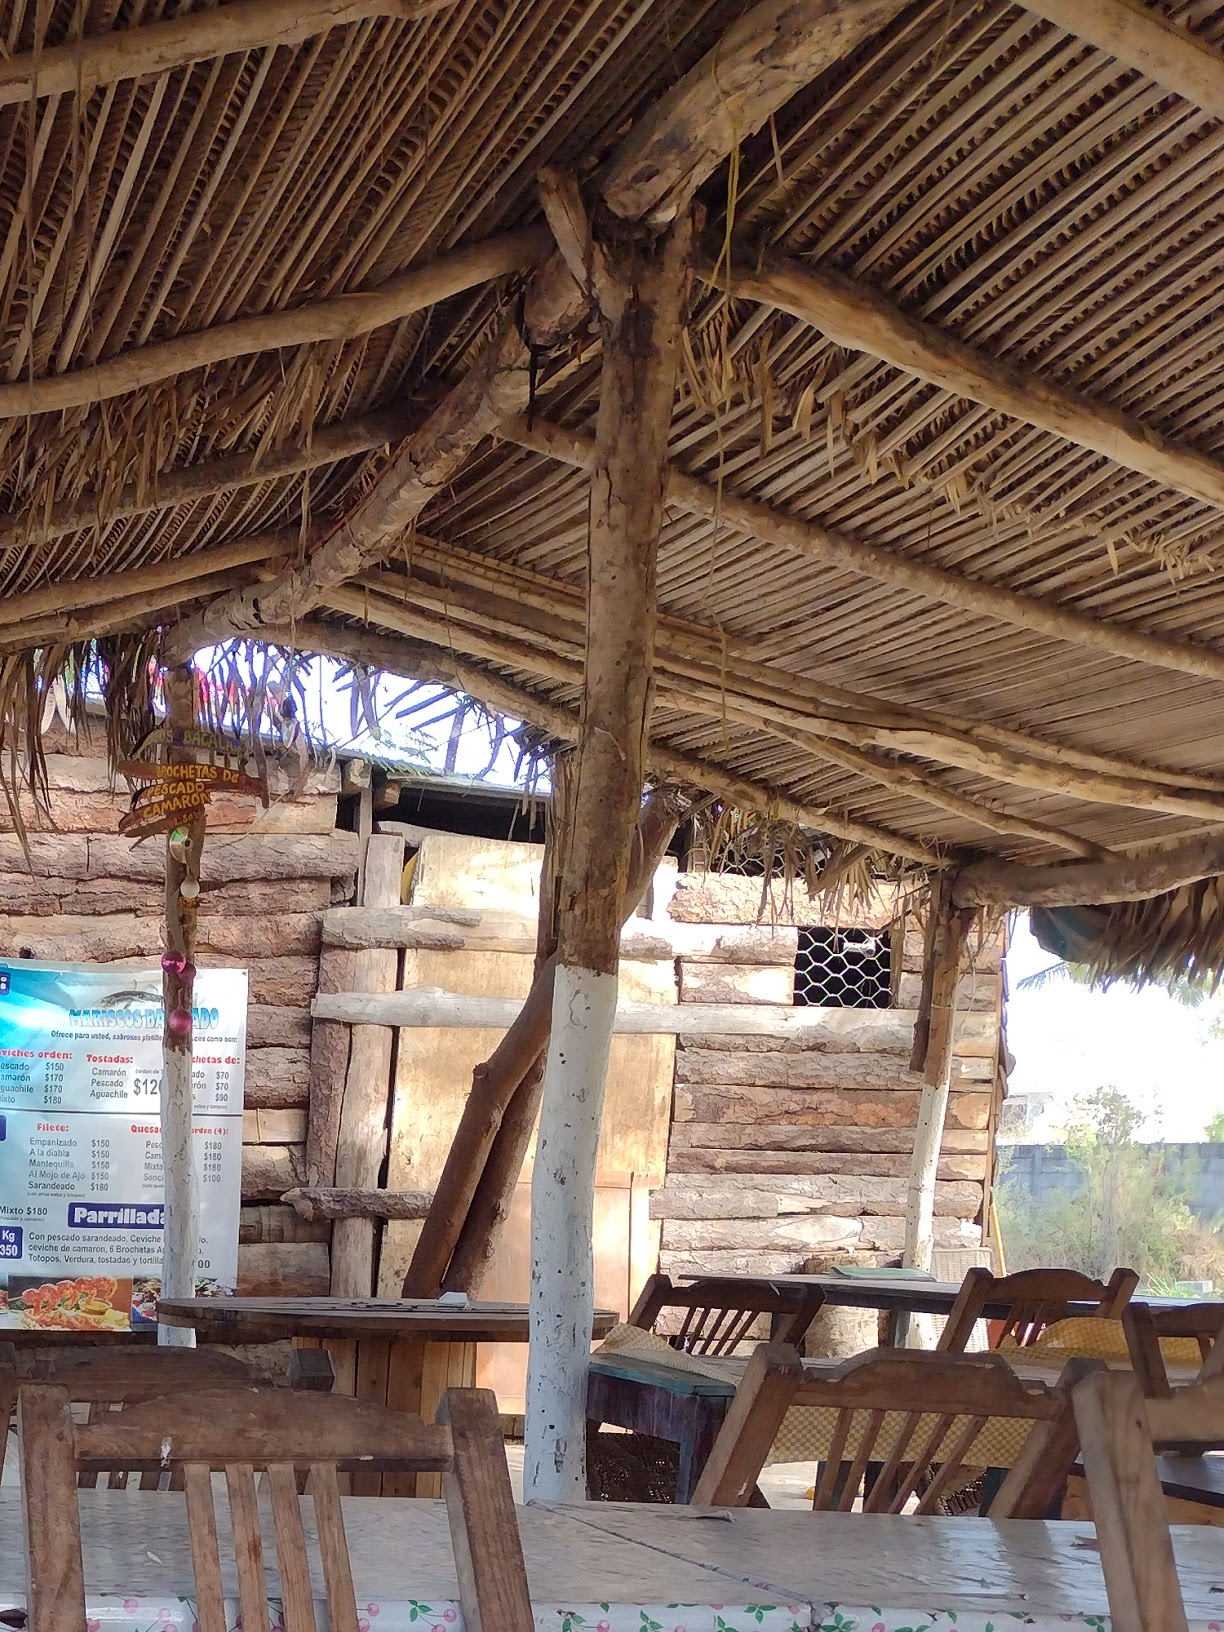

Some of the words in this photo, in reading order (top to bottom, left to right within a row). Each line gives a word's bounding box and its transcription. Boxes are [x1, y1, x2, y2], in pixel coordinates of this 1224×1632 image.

[147, 782, 204, 797] PESCADO
[69, 1009, 143, 1028] MARISCOS
[145, 1008, 219, 1029] BAADO
[51, 1030, 73, 1038] Ofrece
[75, 1032, 89, 1040] para
[142, 1034, 163, 1042] platillo
[38, 1051, 72, 1060] orden:
[86, 1054, 134, 1064] Tostadas:
[191, 1056, 222, 1064] chetas
[224, 1056, 240, 1064] de:
[46, 1062, 64, 1072] $150
[92, 1067, 127, 1077] Camarón
[45, 1073, 63, 1082] $170
[216, 1071, 229, 1080] $70
[44, 1084, 63, 1093] $170
[91, 1078, 124, 1088] Pescado
[134, 1078, 161, 1096] $12
[215, 1082, 229, 1091] $70
[90, 1089, 128, 1099] Aguachile
[215, 1093, 228, 1102] $90
[43, 1095, 62, 1105] $180
[37, 1123, 69, 1132] Filete:
[213, 1127, 229, 1136] (4):
[29, 1137, 77, 1148] Empanizado
[91, 1139, 110, 1148] $150
[145, 1140, 162, 1149] Pesc
[204, 1141, 222, 1150] $180
[29, 1148, 36, 1156] A
[37, 1149, 45, 1157] la
[46, 1149, 70, 1157] diabla
[91, 1150, 110, 1159] $150
[29, 1159, 74, 1170] Mantequilla
[91, 1161, 110, 1170] $150
[203, 1163, 221, 1171] $180
[40, 1171, 59, 1182] Mojo
[60, 1172, 71, 1180] de
[72, 1172, 85, 1182] Ajo
[91, 1172, 109, 1181] $150
[143, 1173, 164, 1181] Senci
[203, 1174, 221, 1183] $100
[28, 1181, 75, 1190] Sarandeado
[0, 1206, 23, 1215] Mixto
[26, 1207, 48, 1216] $180
[2, 1230, 15, 1242] Kg
[29, 1232, 45, 1240] Con
[47, 1234, 80, 1242] pescado
[82, 1234, 128, 1243] sarandeado,
[130, 1234, 161, 1242] Ceviche
[28, 1243, 59, 1252] ceviche
[61, 1244, 70, 1252] de
[72, 1246, 108, 1254] camaron,
[109, 1245, 114, 1253] 6
[116, 1245, 155, 1254] Brochetas
[28, 1254, 62, 1264] Totopos,
[64, 1255, 96, 1264] Verdura,
[98, 1256, 130, 1264] tostadas
[139, 1256, 164, 1264] tortilla
